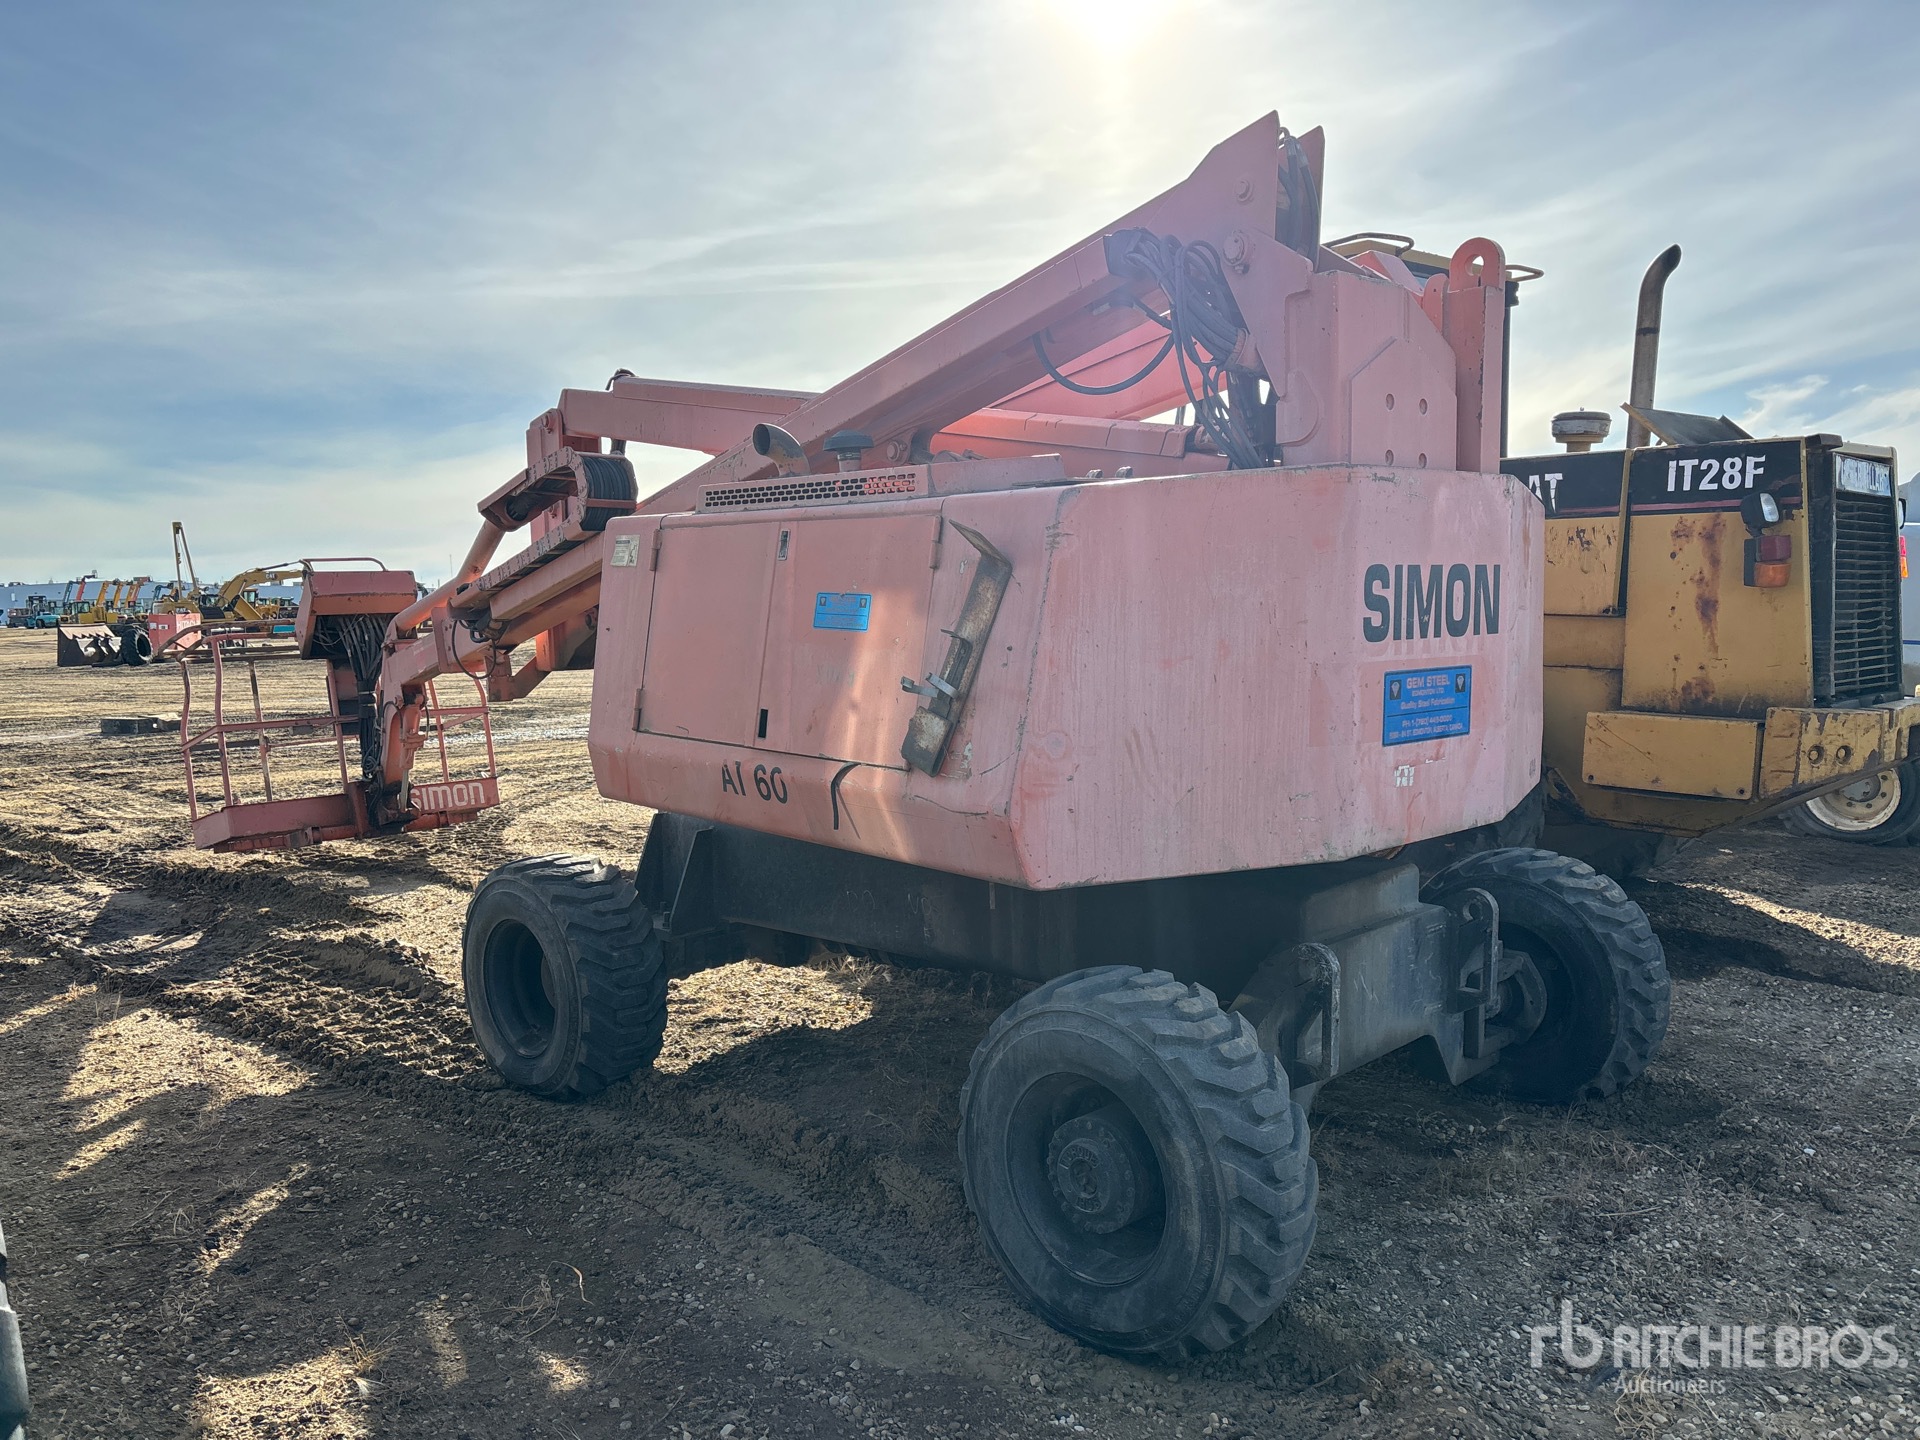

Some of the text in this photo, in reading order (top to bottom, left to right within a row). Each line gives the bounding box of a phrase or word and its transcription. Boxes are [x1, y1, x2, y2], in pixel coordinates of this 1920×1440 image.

[1667, 455, 1766, 492] IT28F
[1363, 564, 1500, 642] SIMON
[1406, 674, 1450, 689] GEM STEEL
[754, 763, 788, 804] 60
